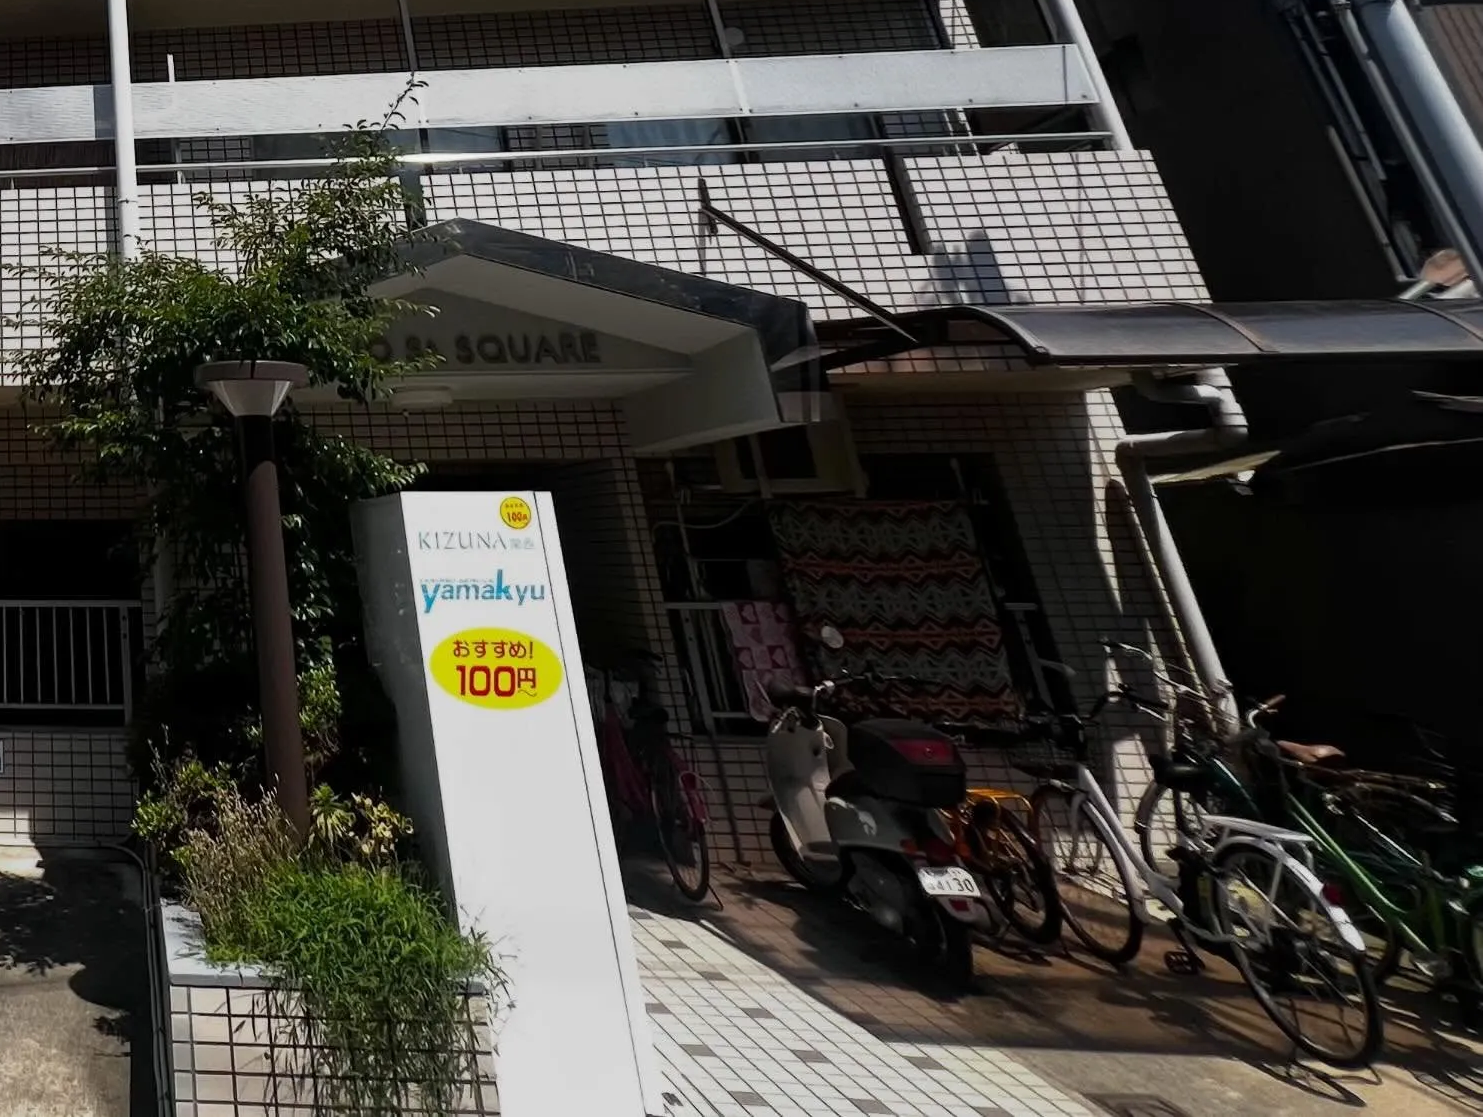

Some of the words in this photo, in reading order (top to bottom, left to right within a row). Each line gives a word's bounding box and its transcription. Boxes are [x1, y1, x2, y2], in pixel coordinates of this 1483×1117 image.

[455, 332, 602, 365] SQUARE
[418, 531, 508, 550] KIZUNA
[421, 569, 545, 613] yamakyu
[452, 639, 534, 659] おすすめ!
